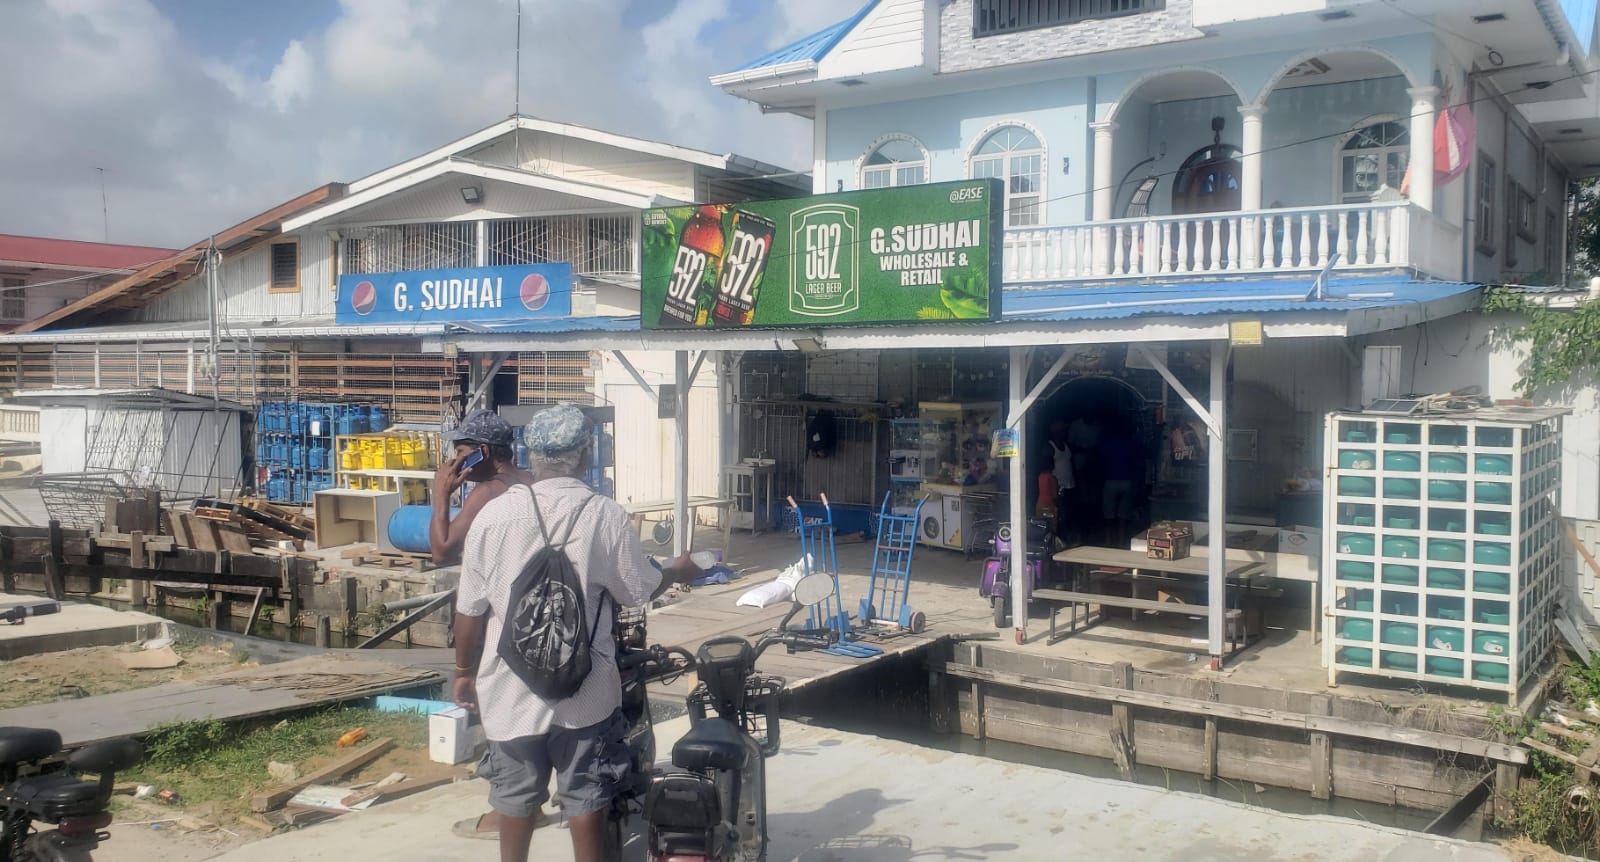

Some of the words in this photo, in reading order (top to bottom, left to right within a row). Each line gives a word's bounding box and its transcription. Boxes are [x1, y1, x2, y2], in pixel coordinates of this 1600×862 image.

[949, 187, 984, 203] @EASE
[805, 223, 841, 280] 592
[870, 219, 980, 254] G.SUDHAI
[668, 245, 706, 305] 592
[721, 230, 766, 303] 592
[880, 251, 955, 271] WHOLESALE
[958, 252, 969, 267] &
[901, 268, 944, 286] RETAIL
[394, 282, 414, 312] G.
[421, 277, 503, 311] SUDHAI
[805, 282, 825, 294] LAGER
[826, 282, 842, 293] BEER
